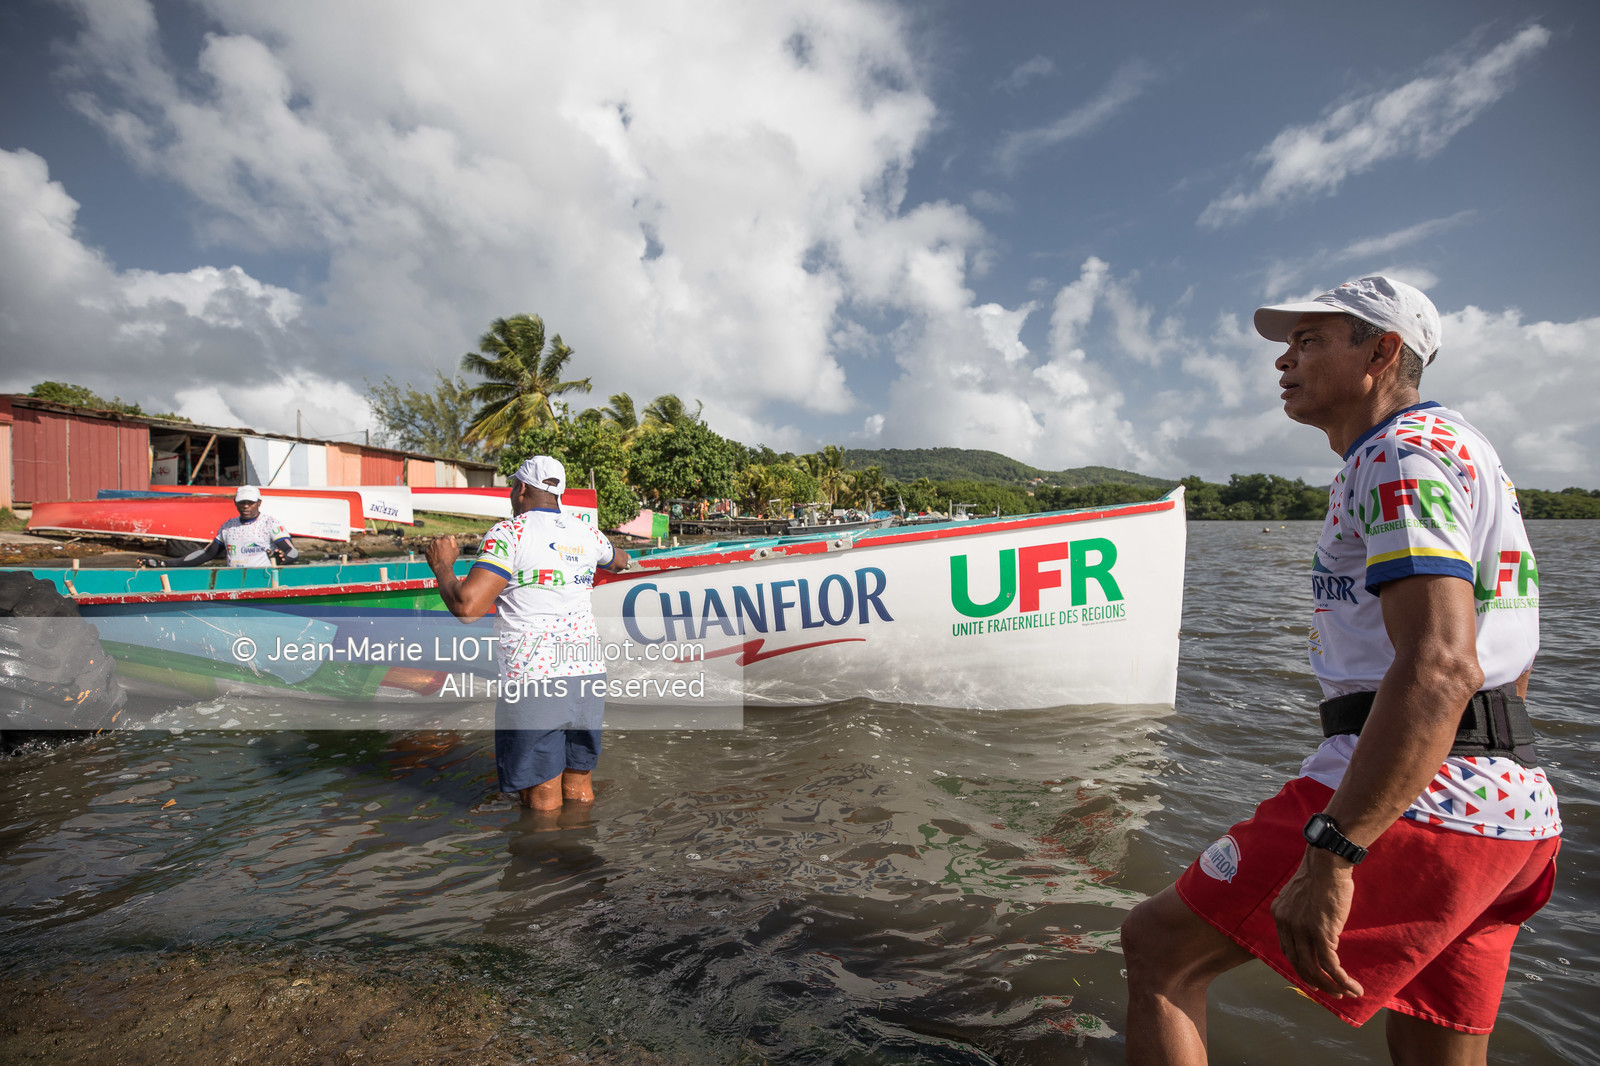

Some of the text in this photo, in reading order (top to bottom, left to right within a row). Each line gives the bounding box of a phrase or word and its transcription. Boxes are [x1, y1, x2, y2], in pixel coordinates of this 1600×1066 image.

[1369, 519, 1411, 537] RATERNELLE
[518, 569, 566, 586] UFR
[950, 537, 1125, 618] UFR
[622, 567, 894, 645] CHANFLOR
[952, 621, 984, 637] UNITE
[987, 612, 1056, 633] FRATERNELLE
[1059, 609, 1079, 626] DES
[1081, 603, 1126, 622] REGIONS
